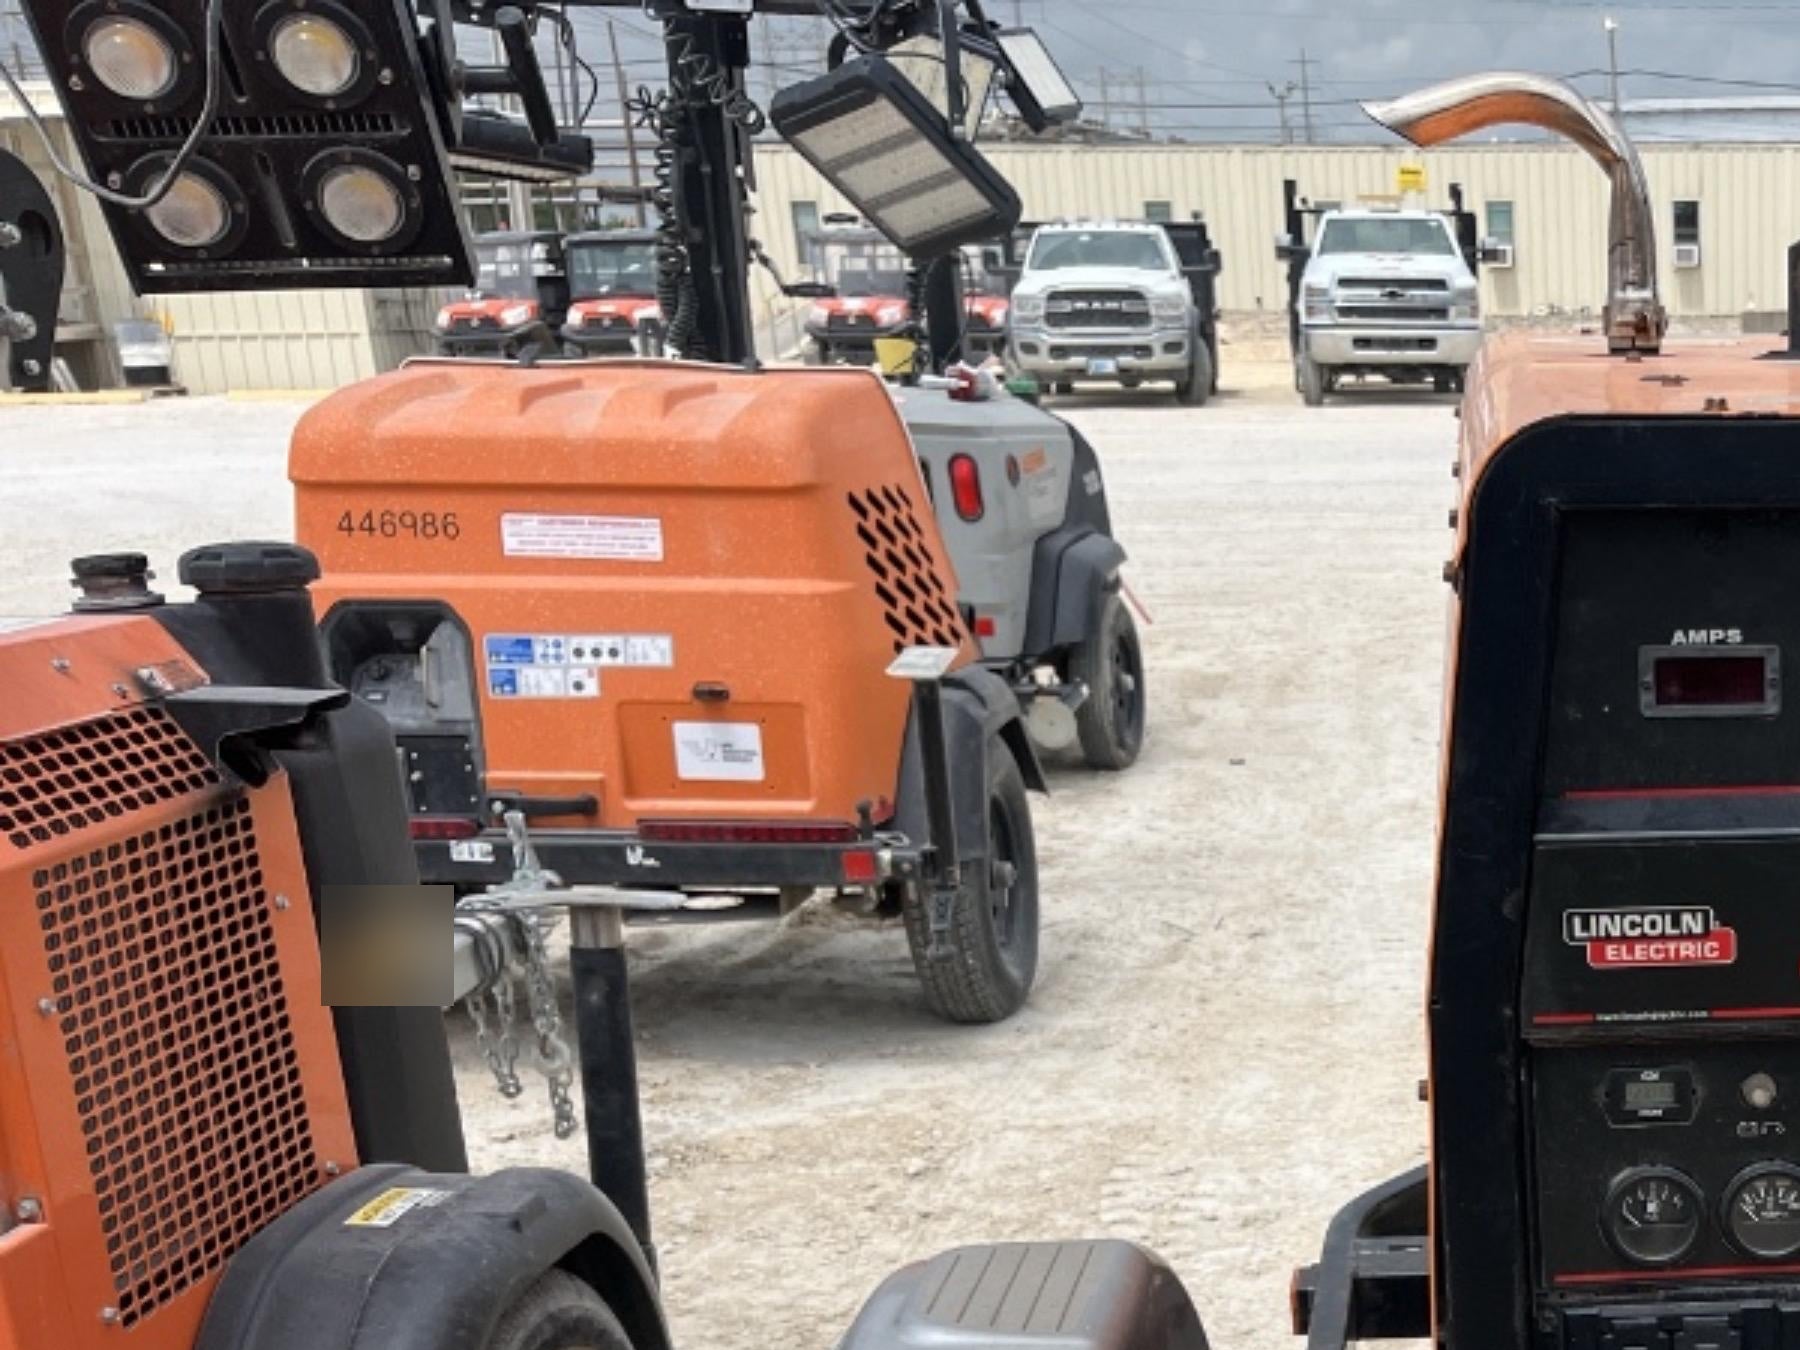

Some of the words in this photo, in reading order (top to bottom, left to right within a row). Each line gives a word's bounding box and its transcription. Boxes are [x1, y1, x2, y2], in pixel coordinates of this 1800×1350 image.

[337, 509, 460, 540] 446986
[1671, 629, 1744, 646] AMPS
[1572, 911, 1706, 938] LINCOLN
[1605, 941, 1720, 962] ELECTRIC
